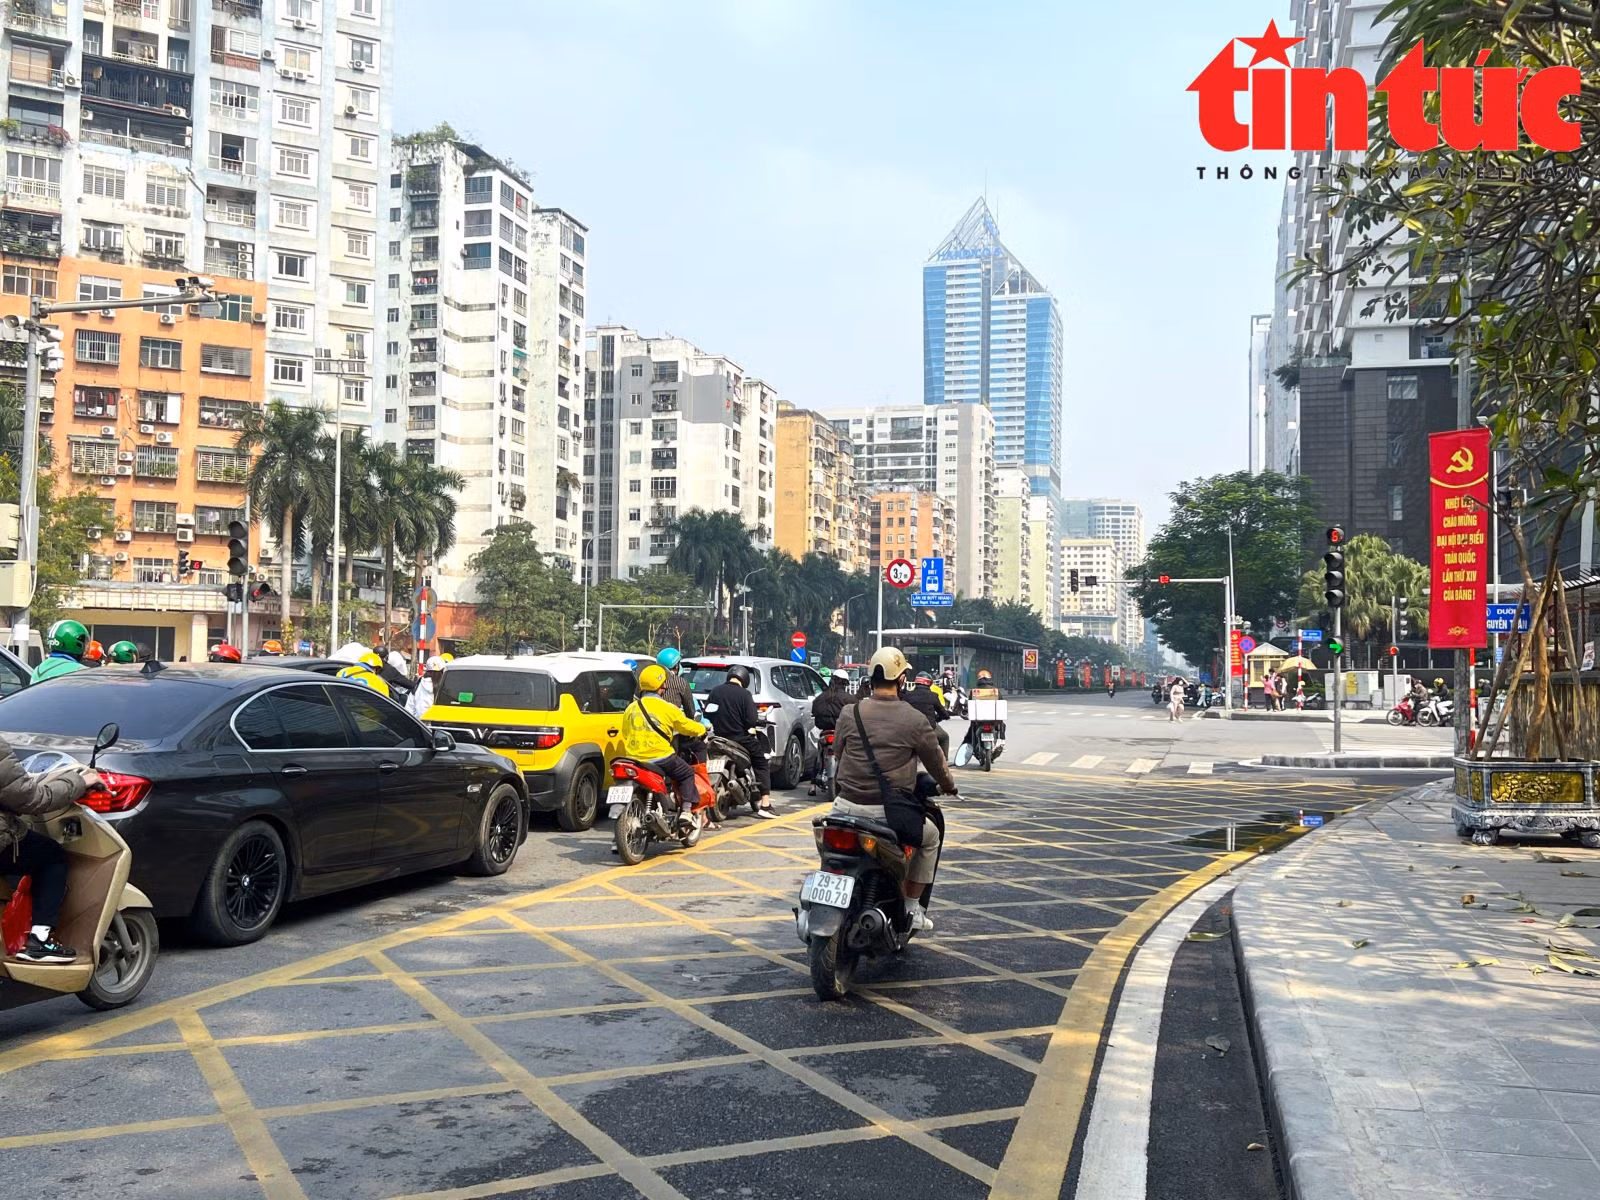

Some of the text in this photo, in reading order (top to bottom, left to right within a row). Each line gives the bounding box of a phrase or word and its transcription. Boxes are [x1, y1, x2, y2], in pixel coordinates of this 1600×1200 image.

[1486, 616, 1508, 630] GUYỄN
[817, 874, 848, 892] 29-Z1
[811, 887, 848, 906] 000.78
